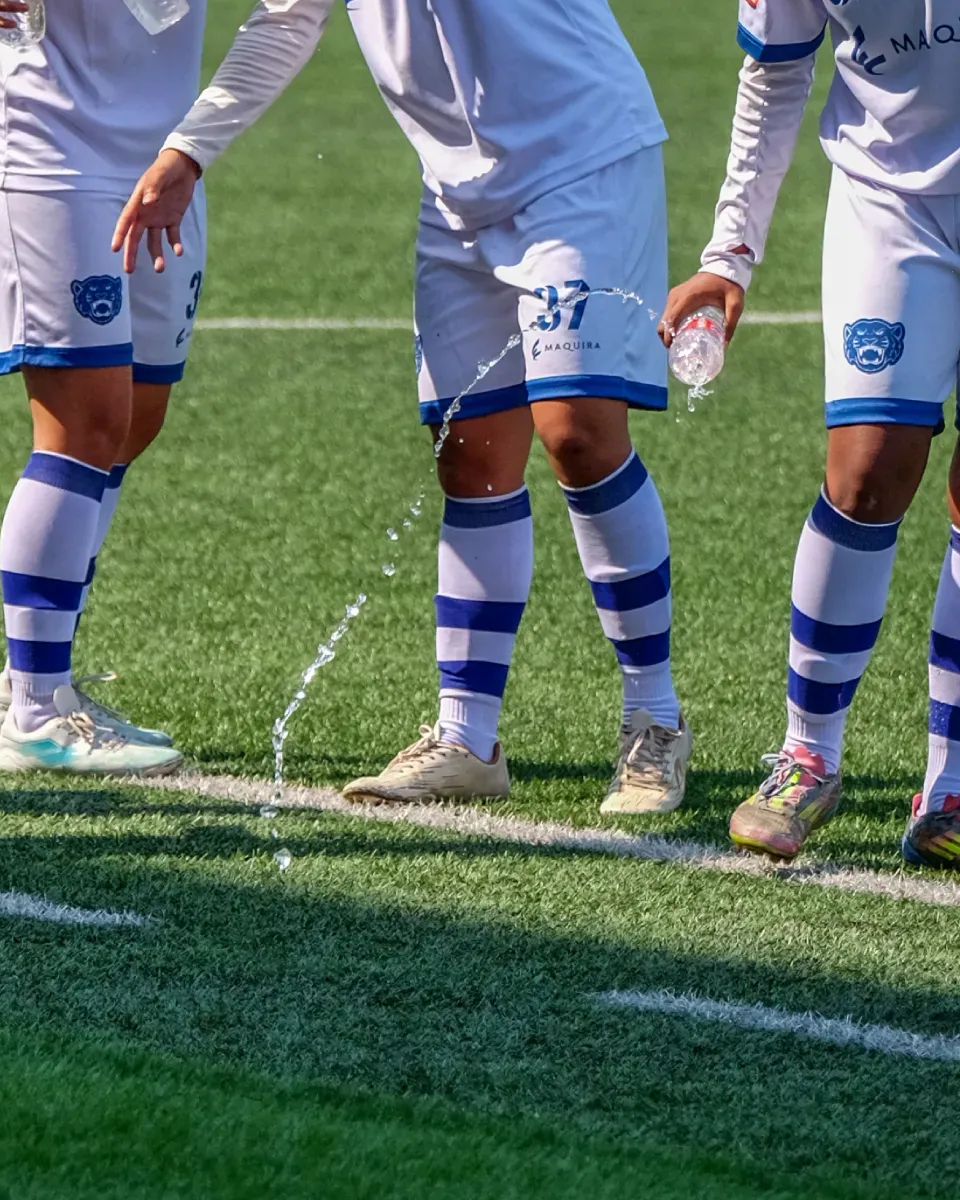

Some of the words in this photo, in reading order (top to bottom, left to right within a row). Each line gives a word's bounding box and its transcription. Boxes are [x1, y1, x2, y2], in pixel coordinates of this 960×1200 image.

[890, 24, 960, 54] MAQ
[185, 269, 203, 320] 3
[534, 279, 590, 332] 37
[544, 341, 601, 352] MAQUIRA
